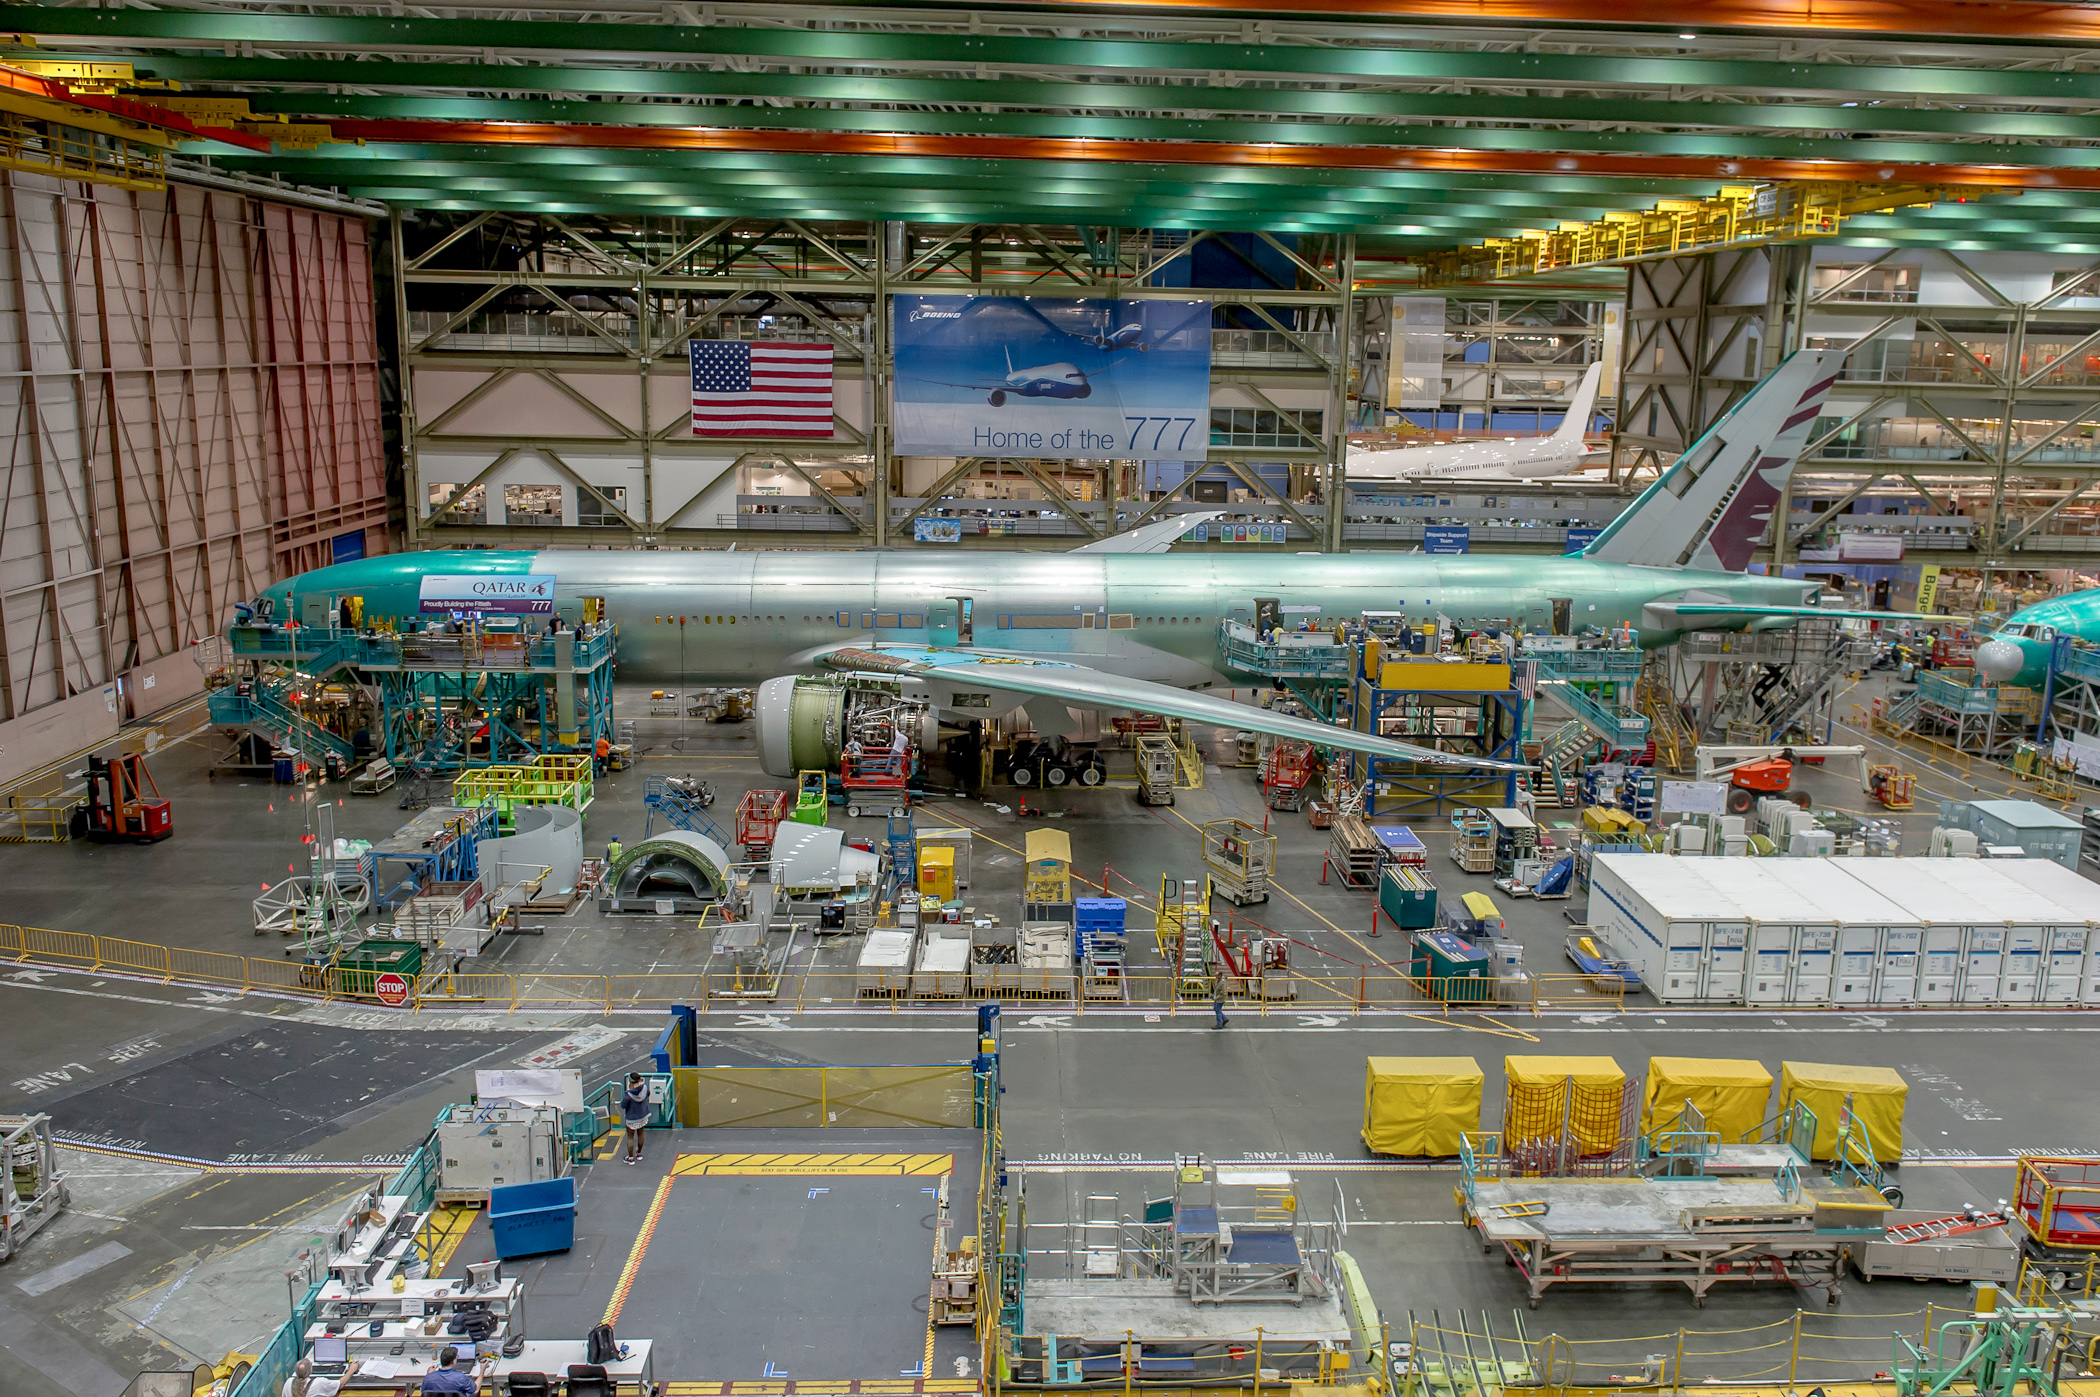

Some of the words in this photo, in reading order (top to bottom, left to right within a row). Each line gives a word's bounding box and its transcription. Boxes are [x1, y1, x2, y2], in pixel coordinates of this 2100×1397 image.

[974, 426, 1043, 449] Home
[1050, 428, 1073, 450] of
[1078, 429, 1114, 450] the
[1125, 416, 1197, 452] 777
[472, 581, 526, 596] QATAR
[1919, 575, 1937, 613] Barge
[423, 601, 444, 609] Proudly
[531, 600, 552, 611] 777
[378, 982, 405, 993] STOP
[10, 1062, 96, 1095] LANE
[53, 1129, 123, 1145] PARKING
[119, 1138, 147, 1149] NO
[1037, 1152, 1113, 1160] PARKING
[1118, 1152, 1142, 1160] NO
[1243, 1151, 1290, 1160] LANE
[1296, 1151, 1335, 1160] FIRE
[1901, 1147, 1934, 1157] LAN
[1938, 1147, 1978, 1157] FIRE
[2007, 1147, 2080, 1157] PARKING
[224, 1153, 278, 1162] LANE
[361, 1153, 414, 1162] RKING
